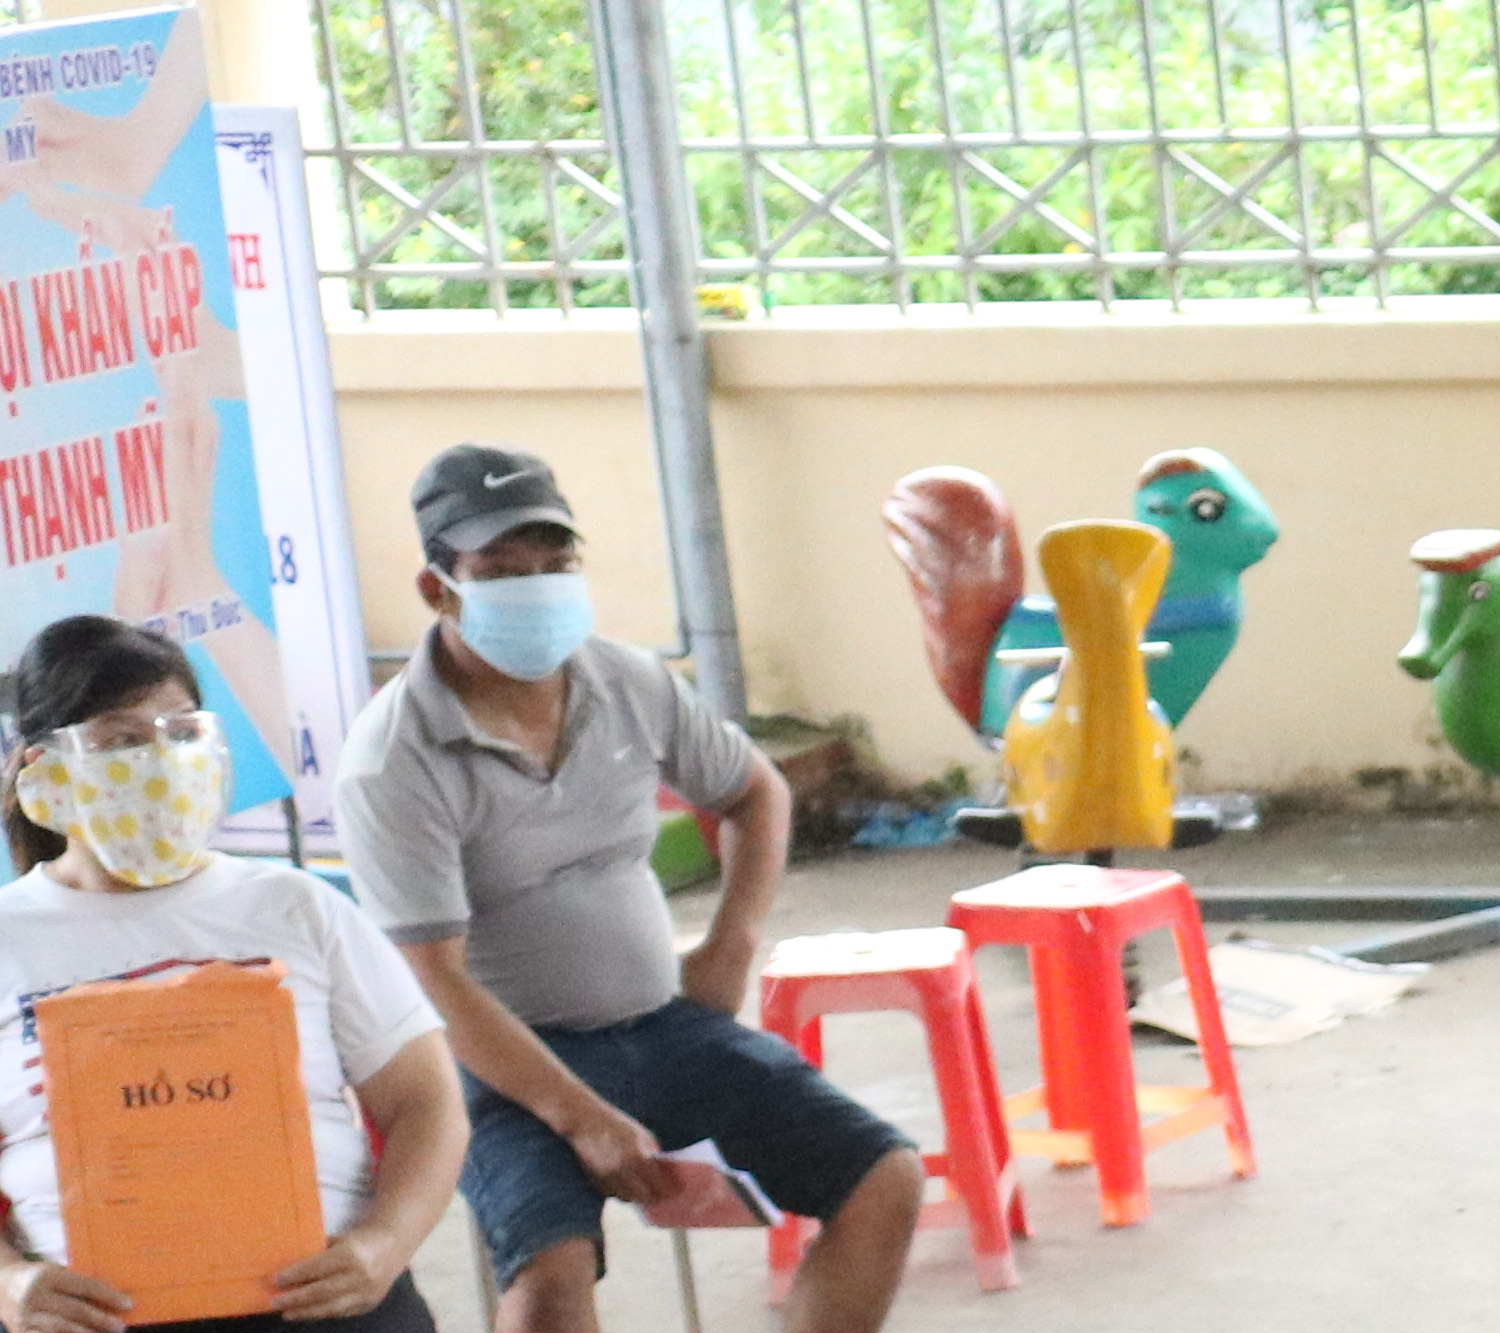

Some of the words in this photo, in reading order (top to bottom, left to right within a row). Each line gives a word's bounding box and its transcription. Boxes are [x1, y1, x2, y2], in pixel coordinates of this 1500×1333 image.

[61, 43, 156, 89] COVID-19
[137, 208, 202, 359] CẤP
[0, 436, 117, 581] THẠNH
